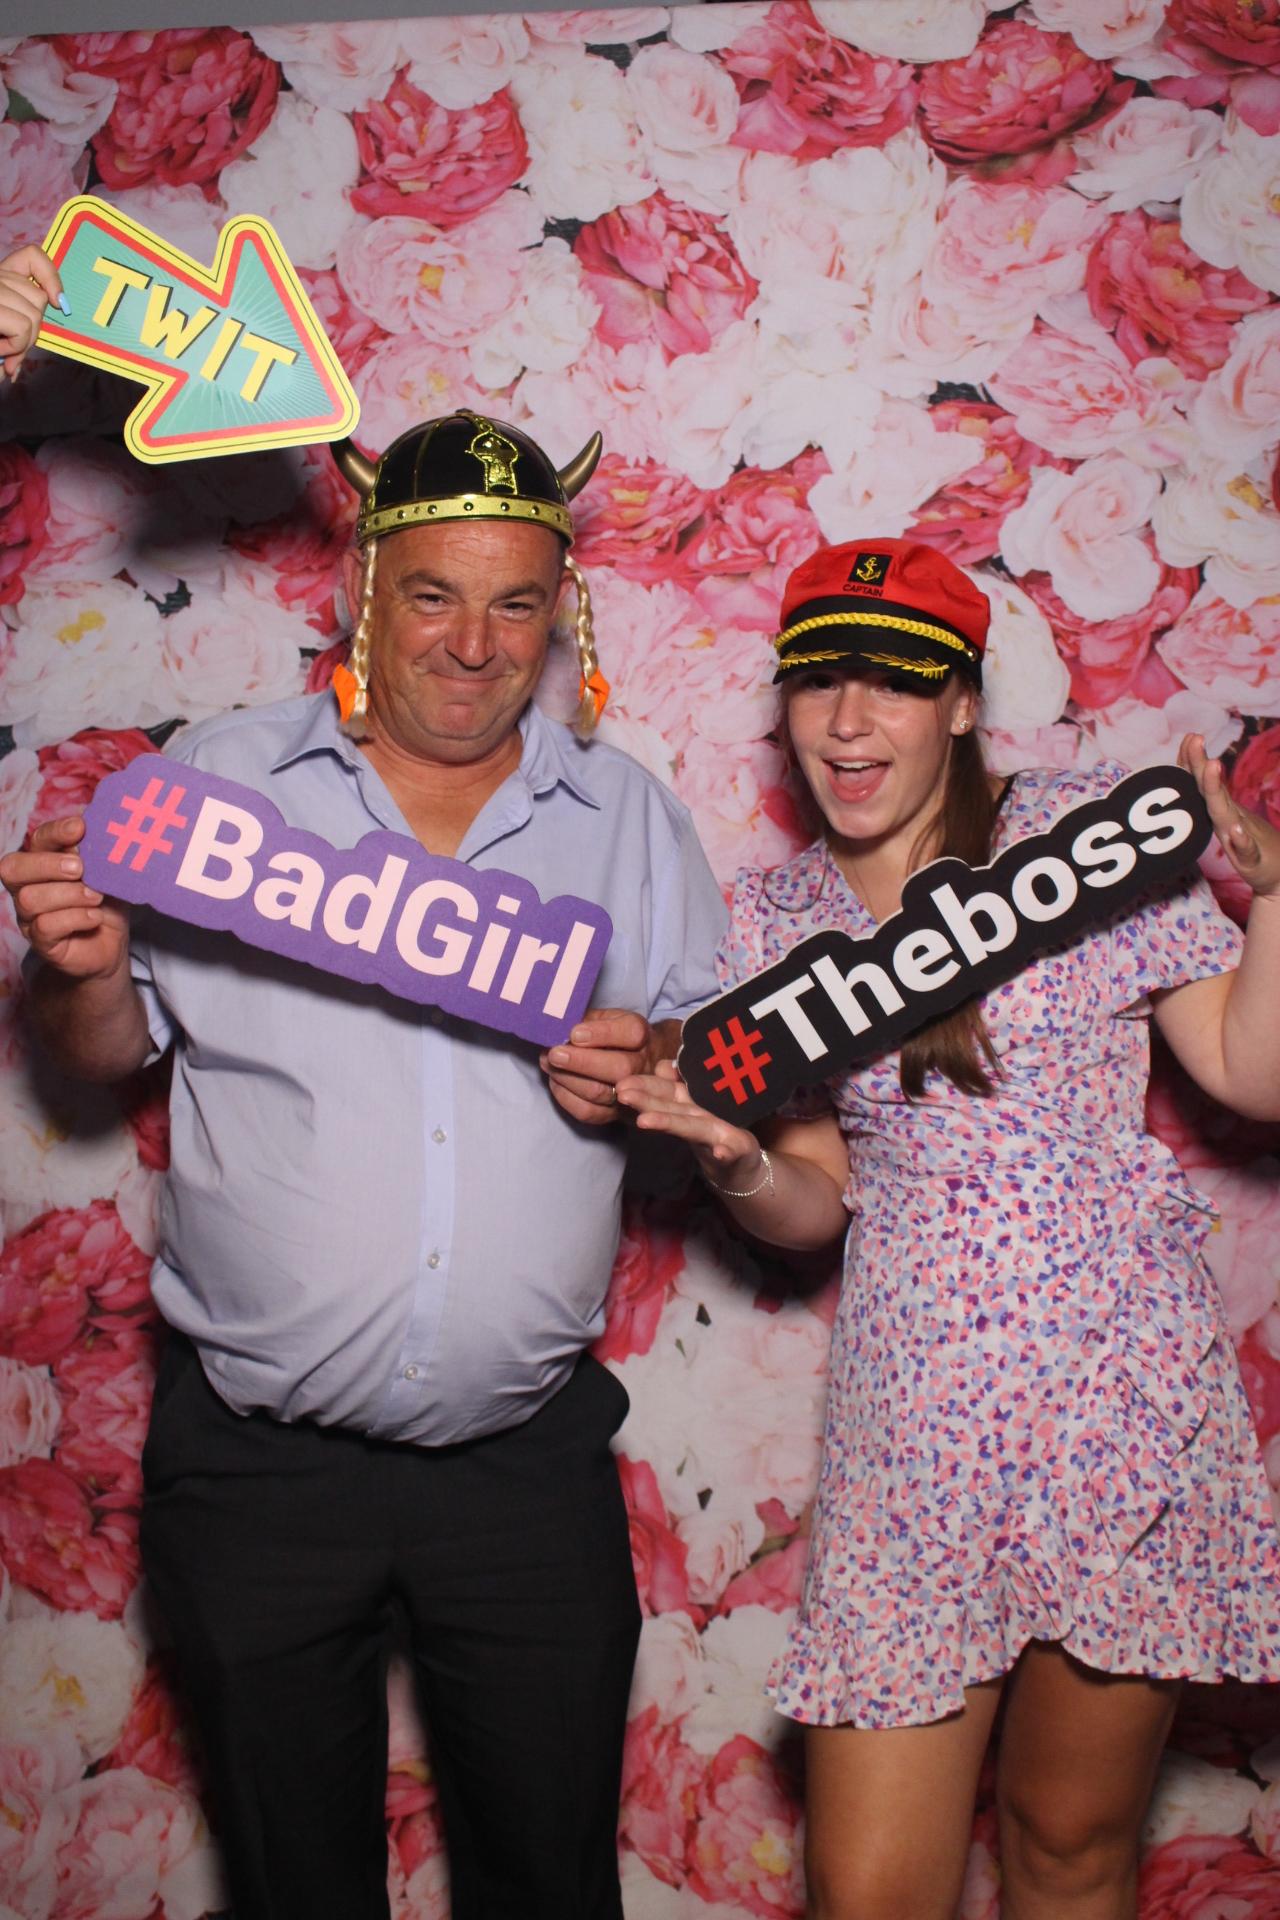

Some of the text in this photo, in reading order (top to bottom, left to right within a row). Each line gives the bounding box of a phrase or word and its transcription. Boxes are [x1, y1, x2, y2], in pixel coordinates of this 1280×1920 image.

[92, 256, 298, 403] TWIT
[842, 584, 884, 597] CAPTAIN
[106, 776, 596, 1020] #BadGirl
[703, 786, 1194, 1106] #Theboss
